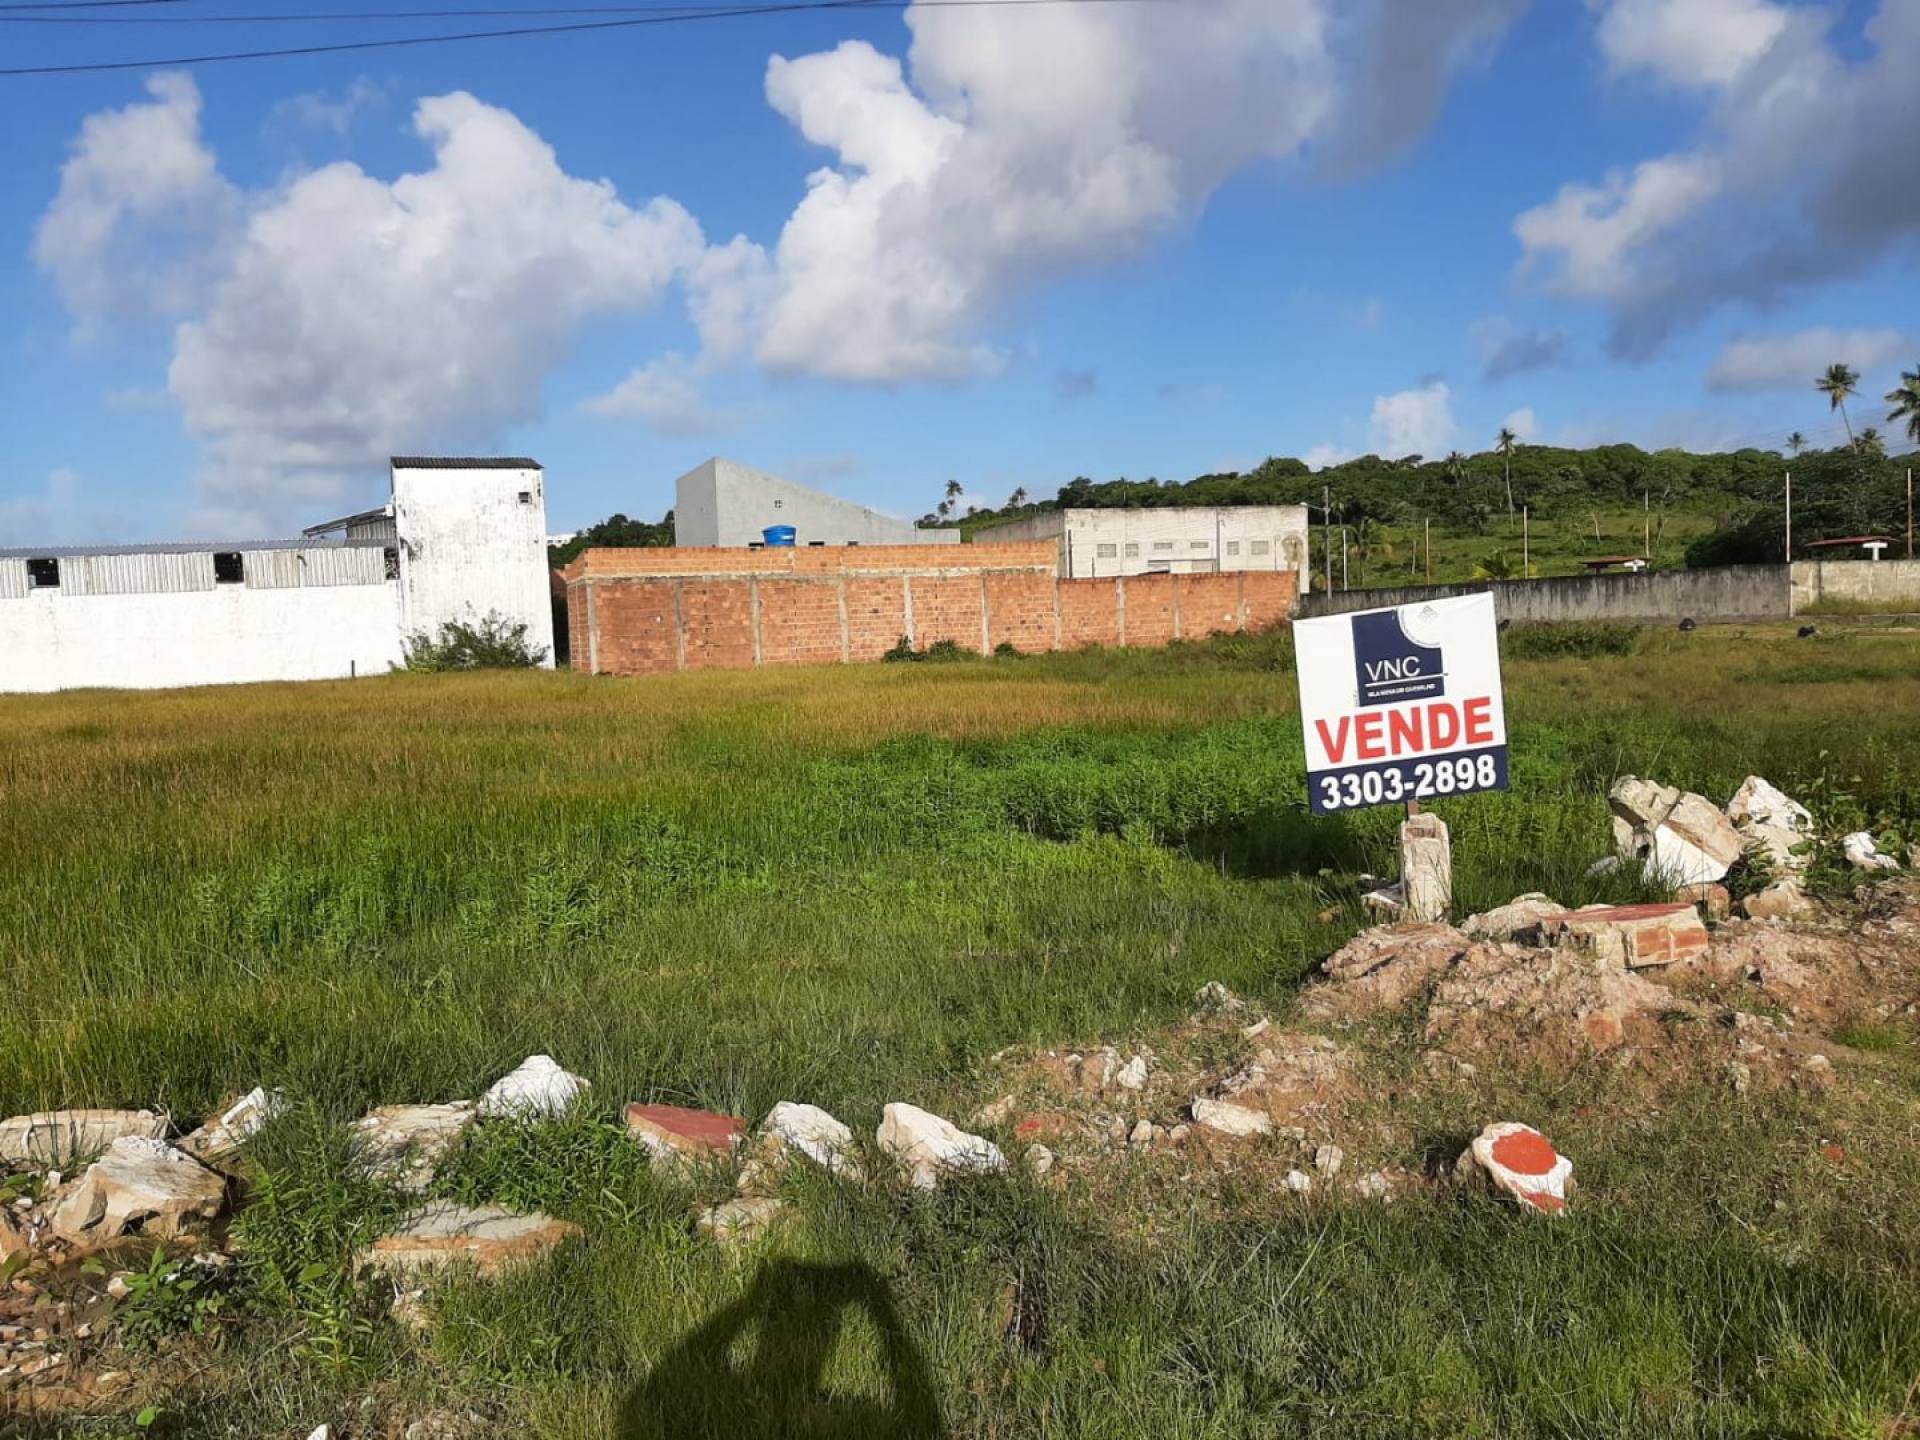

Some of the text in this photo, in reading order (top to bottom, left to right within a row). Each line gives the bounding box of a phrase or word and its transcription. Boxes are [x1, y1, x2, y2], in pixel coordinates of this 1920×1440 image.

[1365, 656, 1421, 681] VNC
[1314, 696, 1494, 764] VENDE
[1320, 754, 1497, 810] 3303-2898
